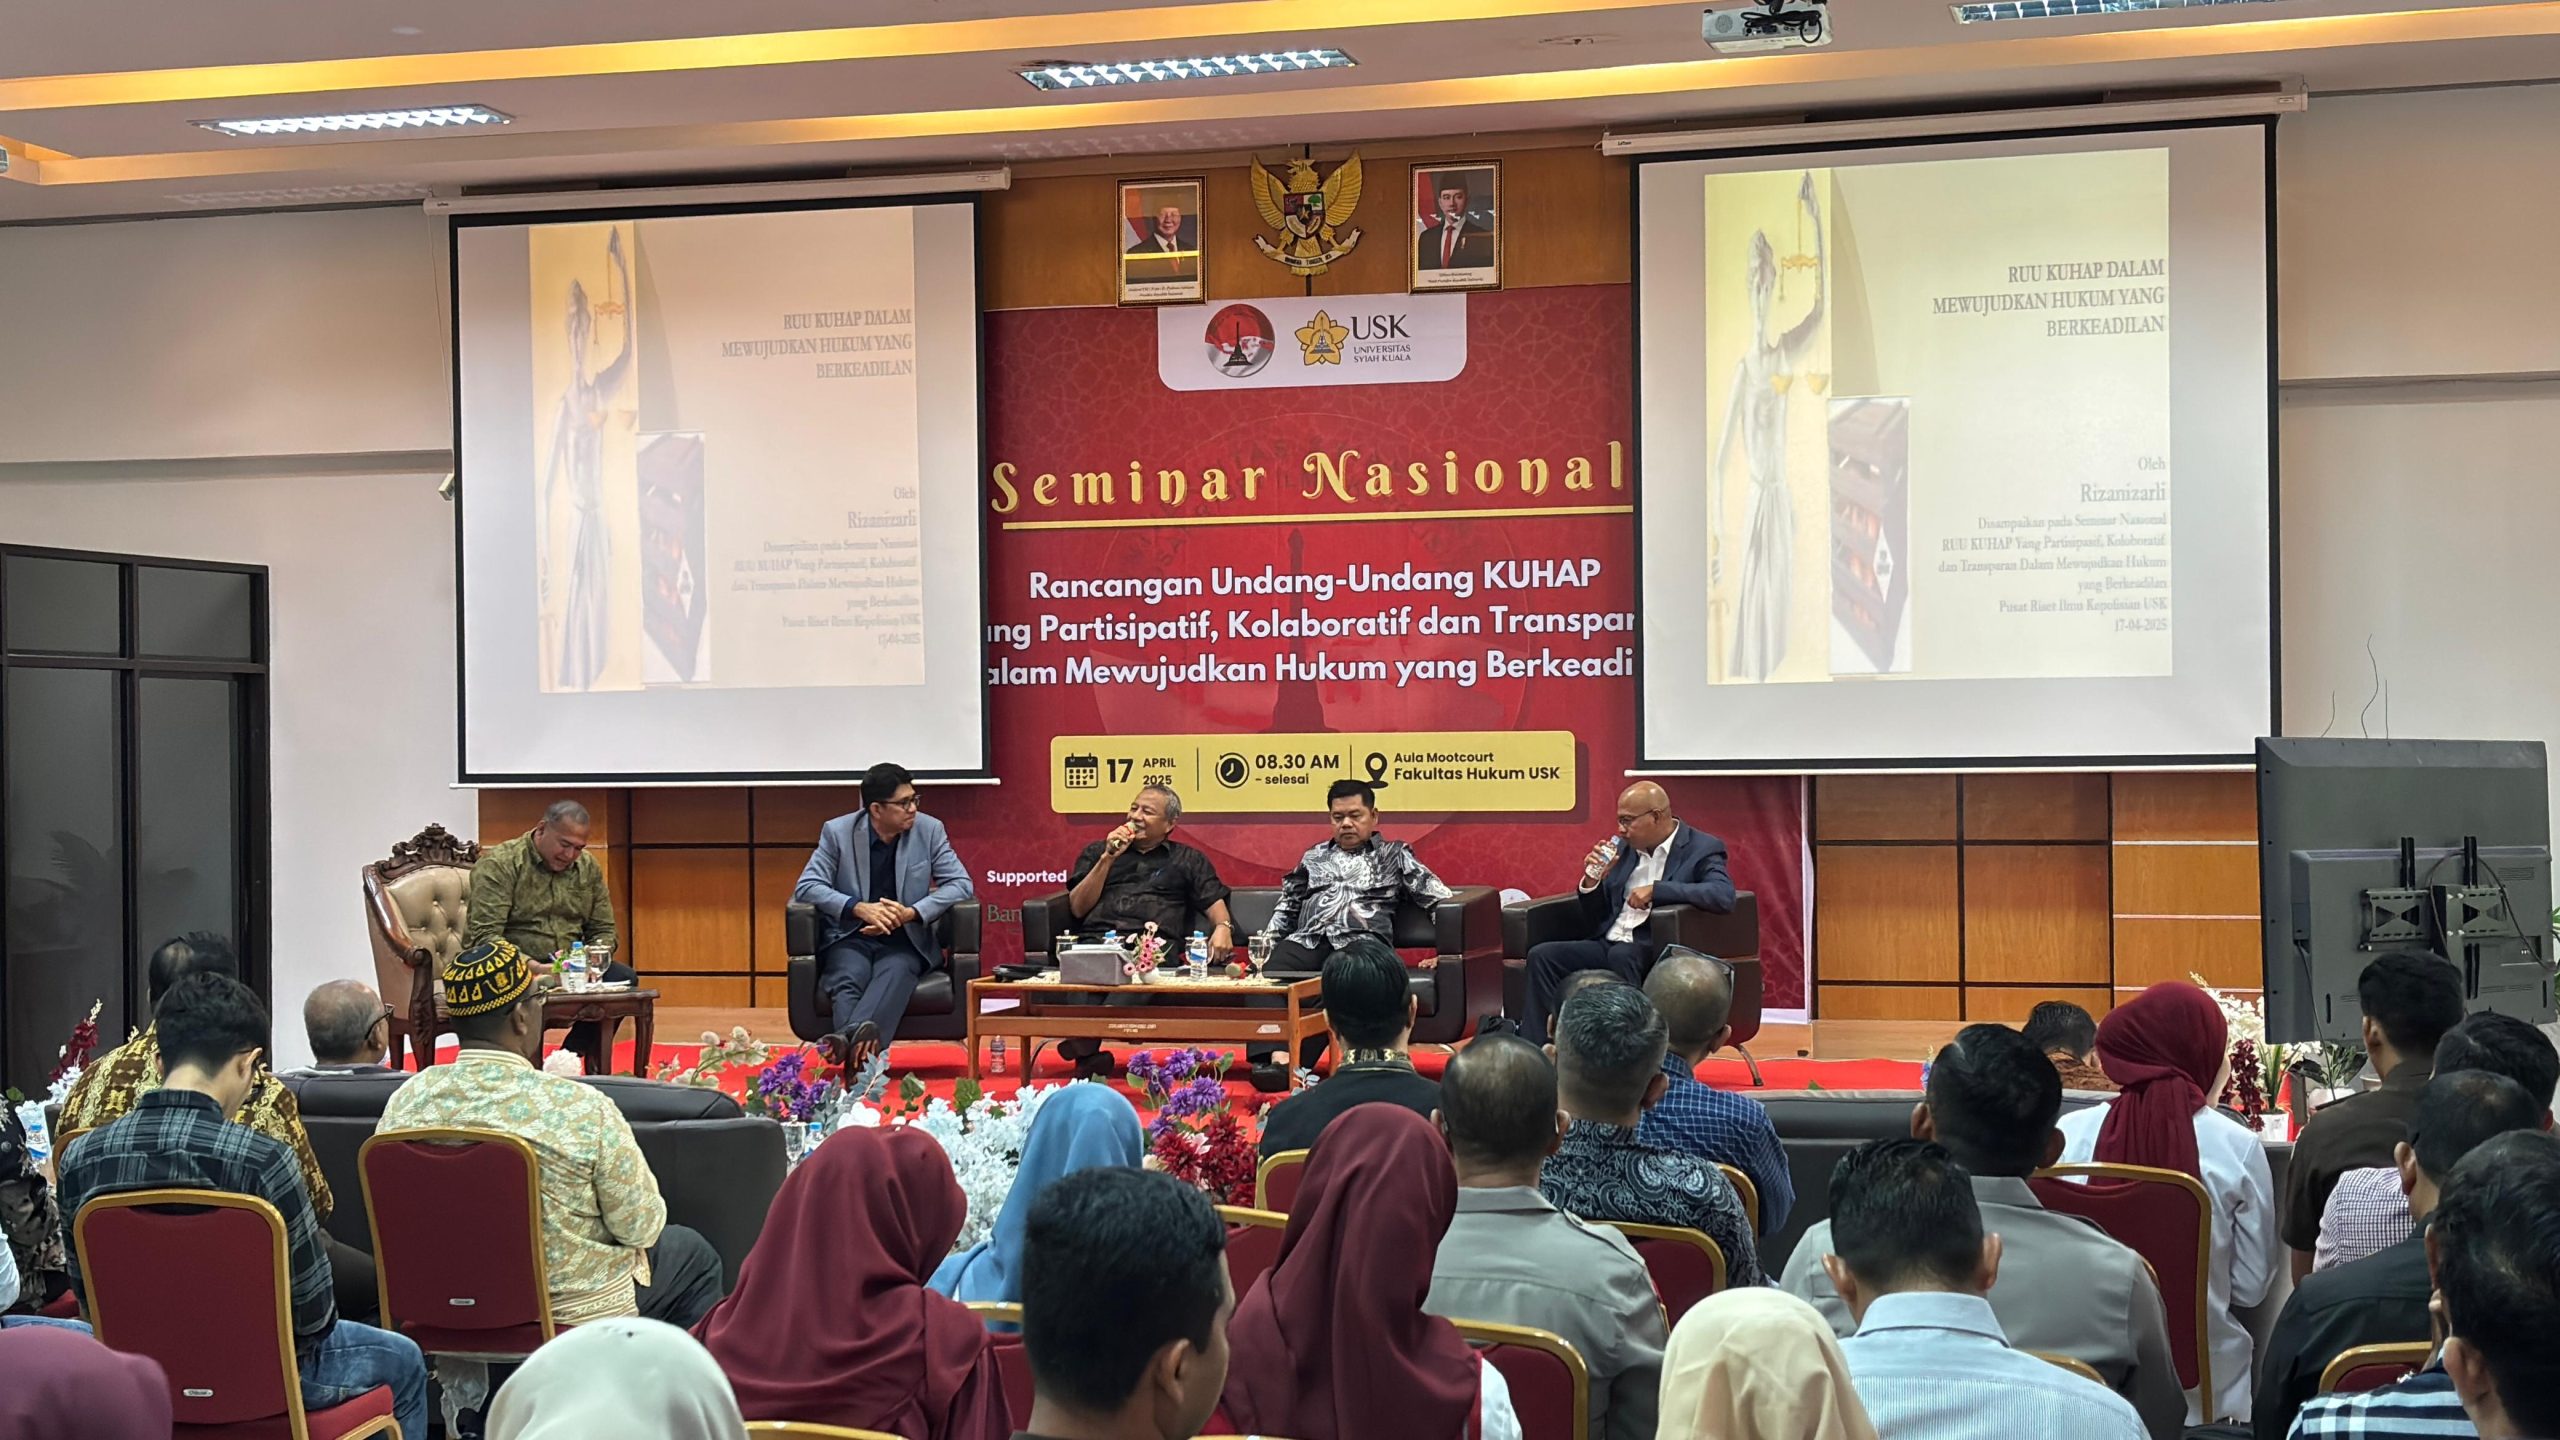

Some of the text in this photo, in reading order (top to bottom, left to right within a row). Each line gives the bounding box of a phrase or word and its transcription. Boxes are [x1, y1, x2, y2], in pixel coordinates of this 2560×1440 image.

[2008, 258, 2165, 283] RUU KUHAP DALAM
[1932, 286, 2165, 316] MEWUJUDKAN HUKUM YANG
[783, 309, 912, 329] RUU KUHAP DALAM
[1351, 314, 1411, 340] USK
[2047, 315, 2165, 337] BERKEADILAN
[721, 334, 912, 359] MEWUJUDKAN HUKUM YANG
[1353, 344, 1411, 355] UNIVERSITAS
[1353, 353, 1411, 363] SYIAH KUALA
[816, 360, 912, 379] BERKEADILAN
[2138, 457, 2166, 470] Oleh
[991, 441, 1625, 513] Seminar Nasional
[2081, 481, 2166, 502] Rizanizarli
[1943, 538, 1968, 551] RUU
[1971, 537, 2012, 551] KUHAP
[1939, 560, 1957, 572] dan
[2126, 555, 2167, 568] Hukum
[1029, 558, 1601, 604] Rancangan Undang-Undang KUHAP
[1999, 600, 2027, 613] Pusat
[2030, 600, 2055, 612] Riset
[2059, 599, 2084, 612] Ilmu
[2143, 597, 2168, 610] USK
[1040, 609, 1219, 648] Partisipatif,
[1228, 605, 1413, 638] Kolaboratif
[1418, 605, 1480, 635] dan
[1065, 653, 1266, 691] Mewujudkan
[1276, 650, 1386, 681] Hukum
[1395, 658, 1477, 687] yang
[1487, 647, 1633, 678] Berkeadi
[1255, 754, 1339, 769] 08.30 AM
[1394, 752, 1494, 763] Aula Mootcourt
[1106, 757, 1176, 784] 17 APRIL
[1265, 772, 1309, 785] selesai
[1394, 766, 1560, 780] Fakultas Hukum USK
[987, 870, 1068, 887] Supported
